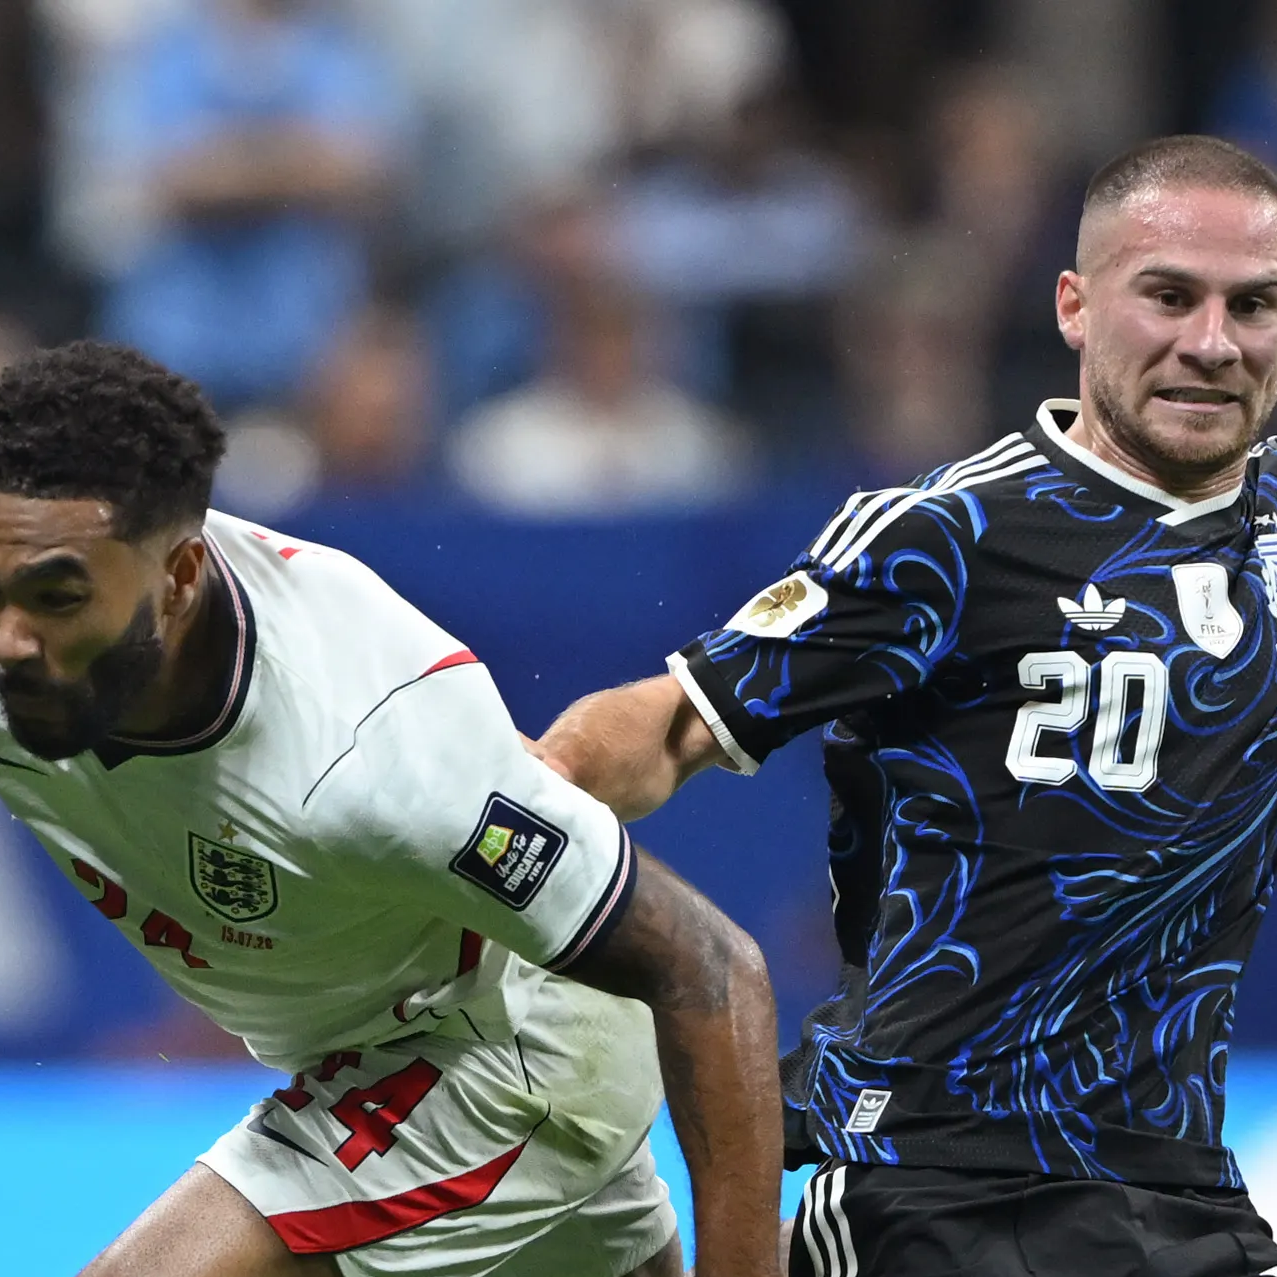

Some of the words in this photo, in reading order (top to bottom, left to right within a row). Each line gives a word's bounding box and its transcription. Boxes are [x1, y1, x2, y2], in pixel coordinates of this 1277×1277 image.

[1200, 624, 1227, 635] FIFA
[1005, 650, 1169, 793] 20
[504, 833, 547, 893] EDUCATION
[527, 861, 545, 882] FIFA
